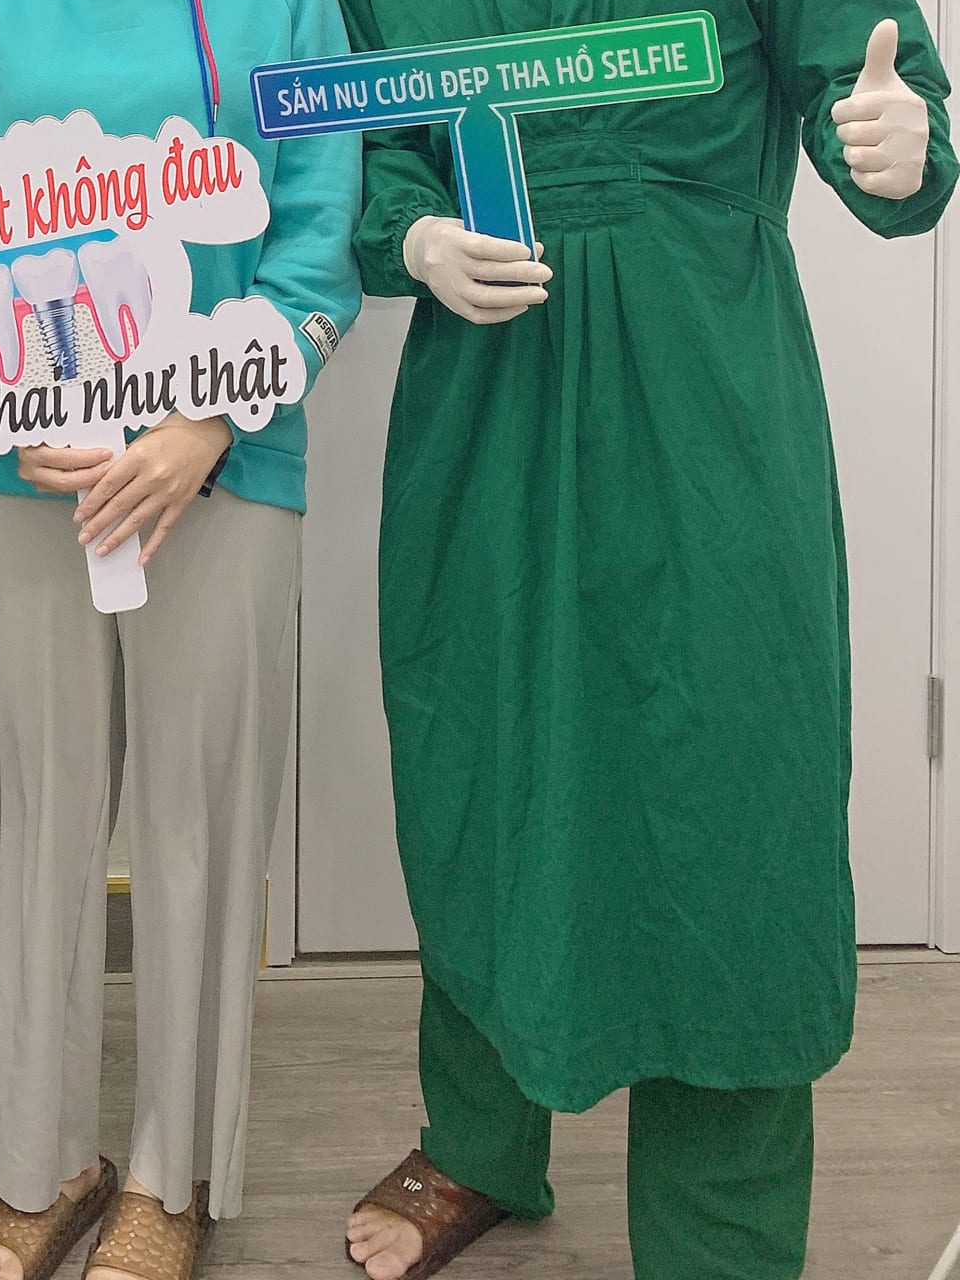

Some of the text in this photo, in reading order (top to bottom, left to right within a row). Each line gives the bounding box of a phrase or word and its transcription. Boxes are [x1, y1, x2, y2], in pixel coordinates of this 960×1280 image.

[277, 42, 688, 116] SẮM NỤ CƯỜI ĐẸP THA HỒ SELFIE
[22, 155, 154, 231] không
[162, 136, 243, 206] đau
[83, 360, 177, 423] như
[190, 338, 287, 417] thật
[403, 1177, 423, 1192] VIP
